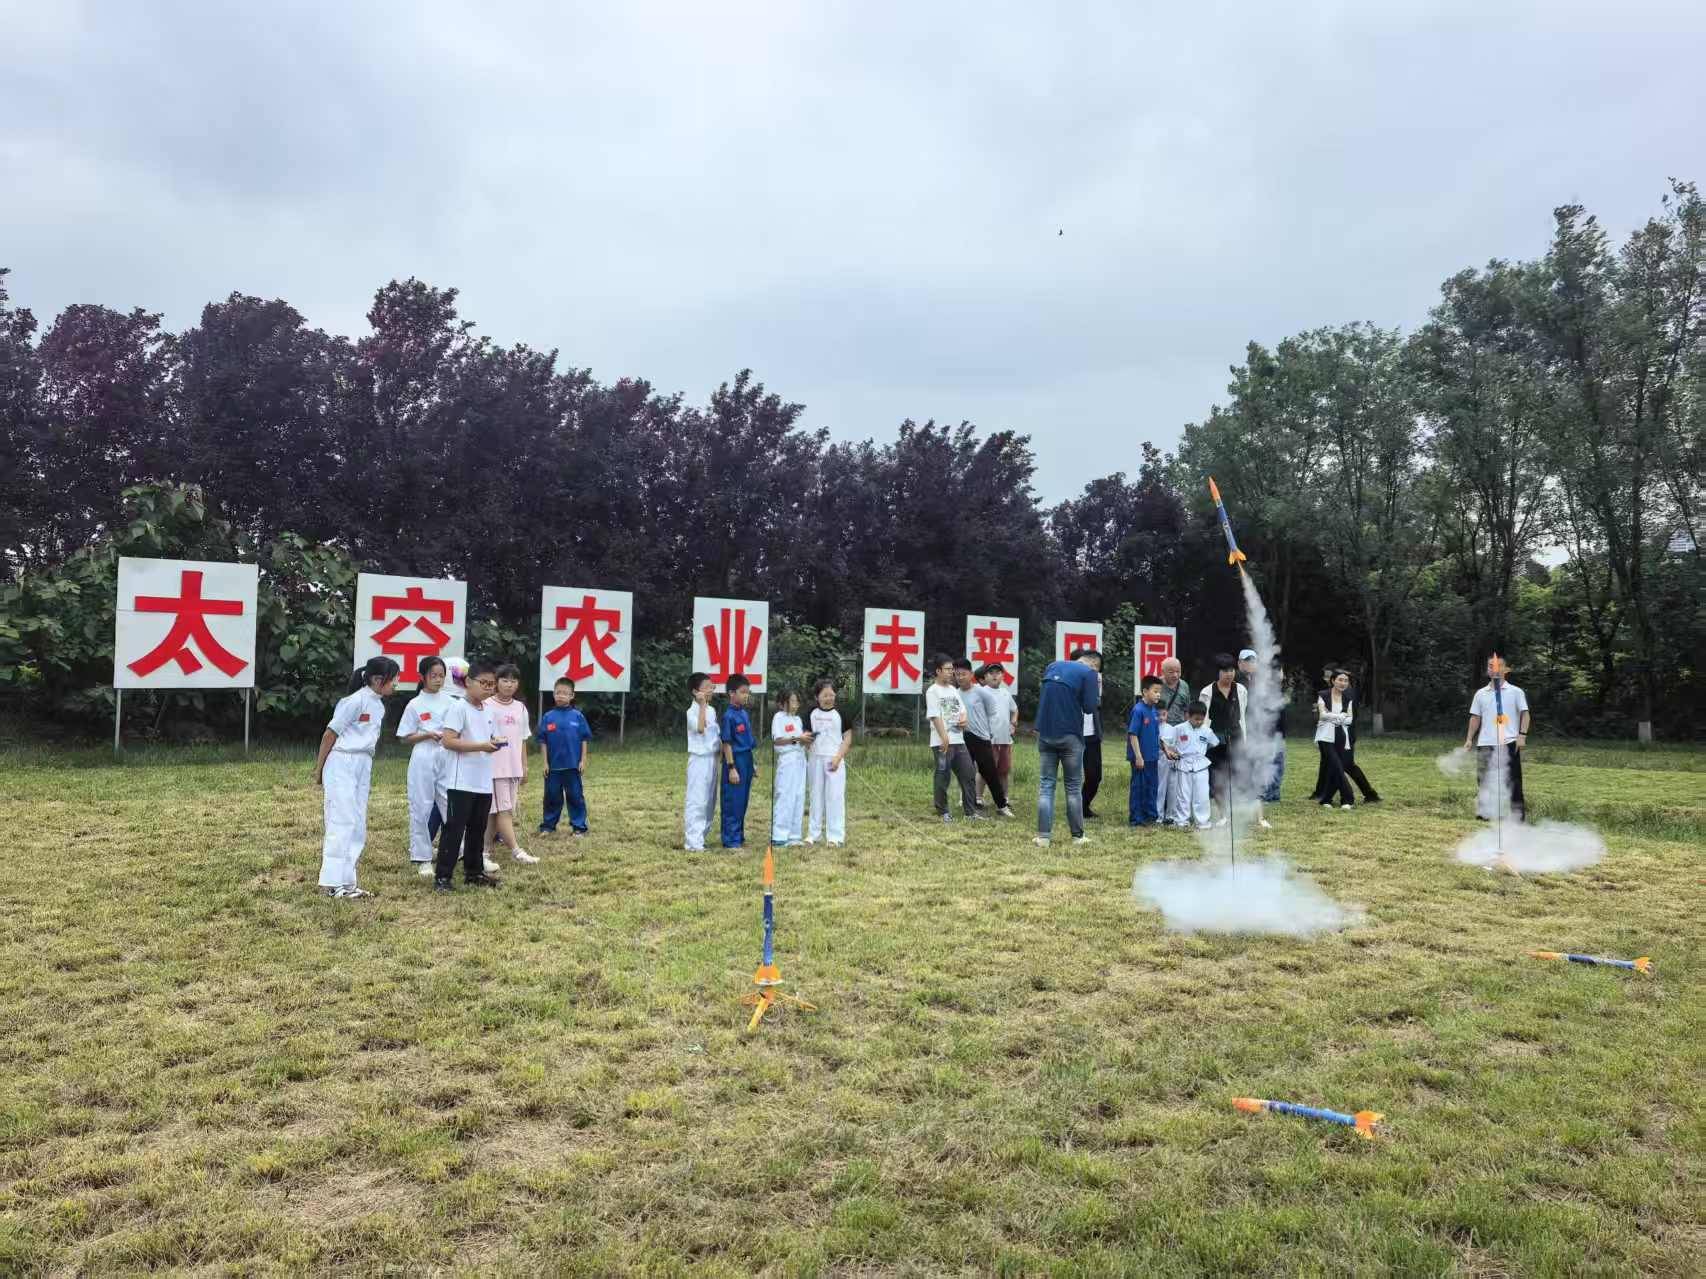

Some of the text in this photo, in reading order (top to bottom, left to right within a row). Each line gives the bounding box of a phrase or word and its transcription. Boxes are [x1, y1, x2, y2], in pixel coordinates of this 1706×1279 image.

[128, 570, 248, 678] 太
[370, 586, 455, 684] 空
[545, 595, 625, 683] 农
[703, 607, 763, 685] 业
[868, 614, 921, 689] 未
[971, 620, 1015, 686] 来
